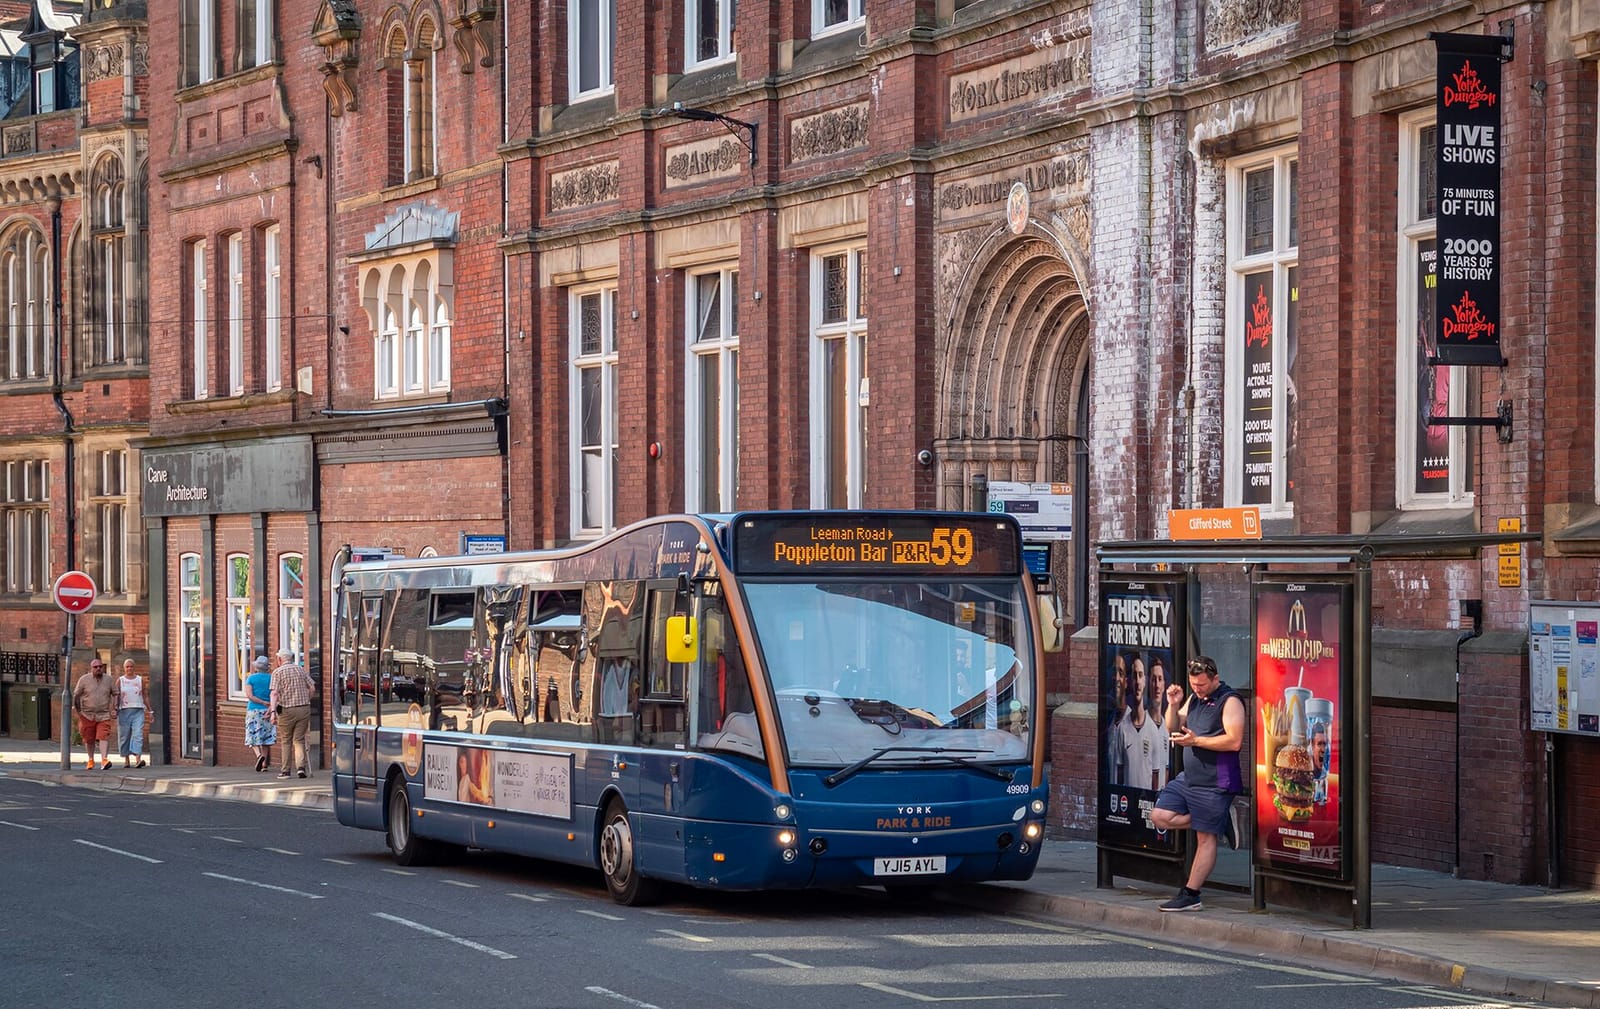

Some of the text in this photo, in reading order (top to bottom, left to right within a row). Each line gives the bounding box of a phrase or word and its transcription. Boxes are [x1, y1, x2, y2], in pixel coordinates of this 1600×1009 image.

[1453, 73, 1486, 93] York
[1444, 86, 1496, 110] Dungeon
[1444, 124, 1494, 147] LIVE
[1443, 147, 1495, 164] SHOWS
[1443, 188, 1494, 199] 75 MINUTES
[1442, 200, 1495, 216] OF FUN
[1444, 238, 1492, 255] 2000
[1420, 250, 1436, 262] VENG
[1444, 256, 1492, 267] YEARS OF
[1444, 267, 1492, 280] HISTORY
[1452, 305, 1486, 323] York
[1247, 321, 1272, 348] Dunge
[1442, 317, 1495, 340] Dungeon
[1252, 362, 1271, 374] 10 LIVE
[1247, 375, 1273, 387] ACTOR-LE
[1252, 388, 1271, 399] SHOWS
[1245, 419, 1272, 431] 2000 YEA
[1246, 432, 1272, 444] OF HISTOR
[148, 467, 167, 482] Carve
[1246, 463, 1272, 473] 75 MINUTE
[1251, 476, 1270, 486] OF FUN
[166, 484, 207, 501] Architecture
[990, 502, 1003, 512] 59
[1189, 517, 1254, 529] Clifford Street TD
[811, 527, 885, 540] Leeman Road
[775, 528, 973, 566] Poppleton Bar P&R 59
[1108, 599, 1170, 624] THIRSTY
[1108, 624, 1170, 647] FOR THE WIN
[1269, 638, 1302, 659] WORLD
[1304, 640, 1322, 662] CUP
[1006, 784, 1029, 794] 49909
[876, 816, 950, 829] PARK & RIDE
[883, 859, 938, 872] YJ15 AYL
